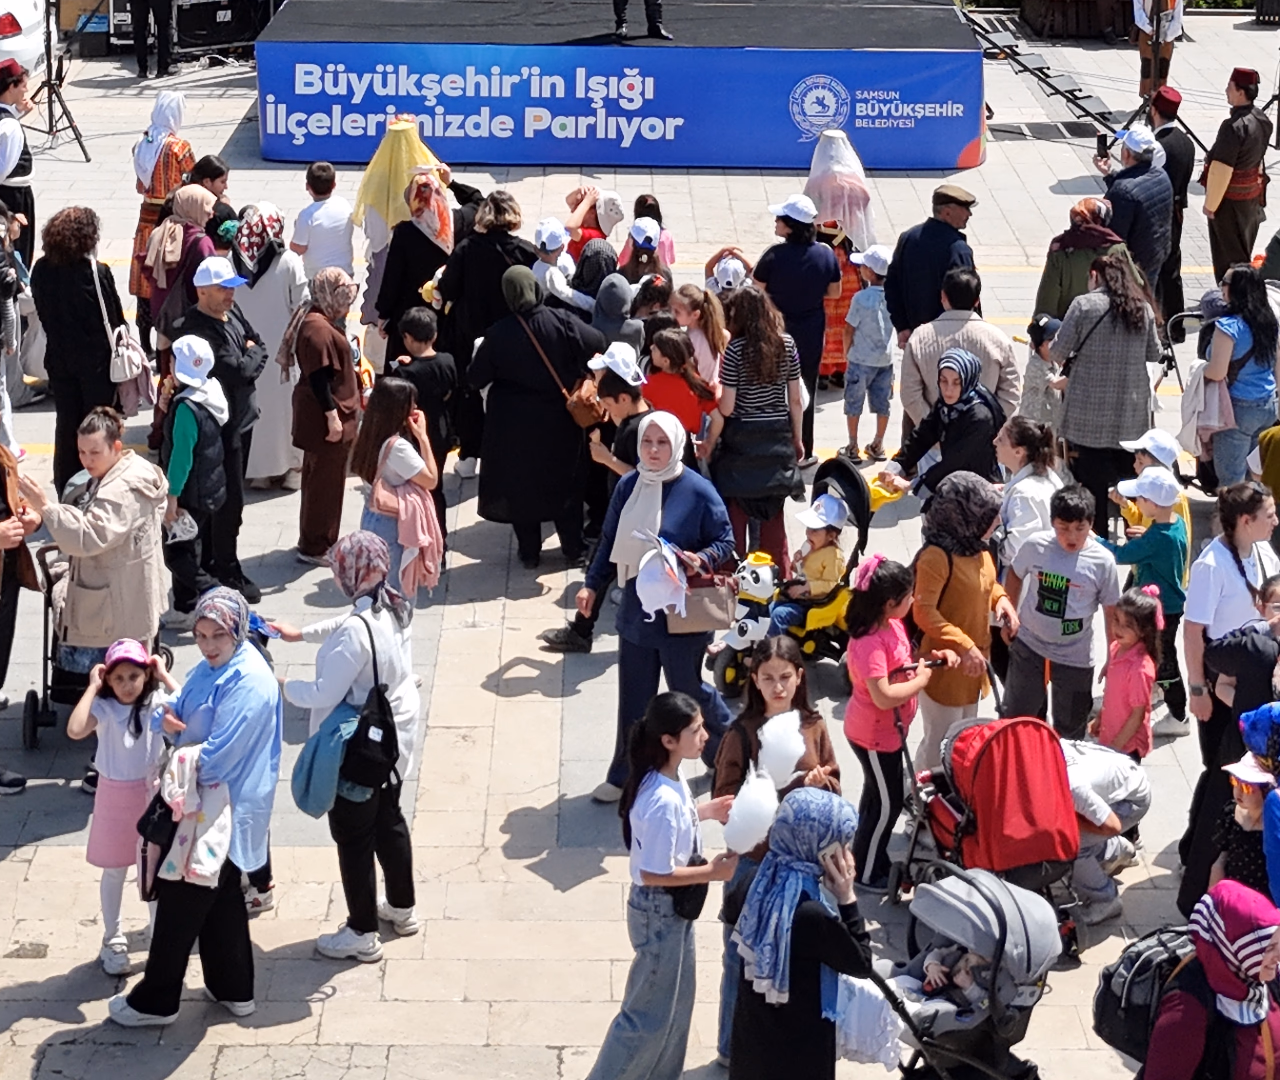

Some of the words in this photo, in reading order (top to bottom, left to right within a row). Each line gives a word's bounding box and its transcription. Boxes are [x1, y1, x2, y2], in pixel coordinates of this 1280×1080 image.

[294, 63, 565, 107] Büyükşehir'in
[575, 67, 654, 110] Işığı
[855, 90, 900, 101] SAMSUN
[855, 100, 964, 119] BÜYÜKŞEHİR
[524, 106, 684, 148] Parlıyor
[855, 118, 915, 128] BELEDİYESİ
